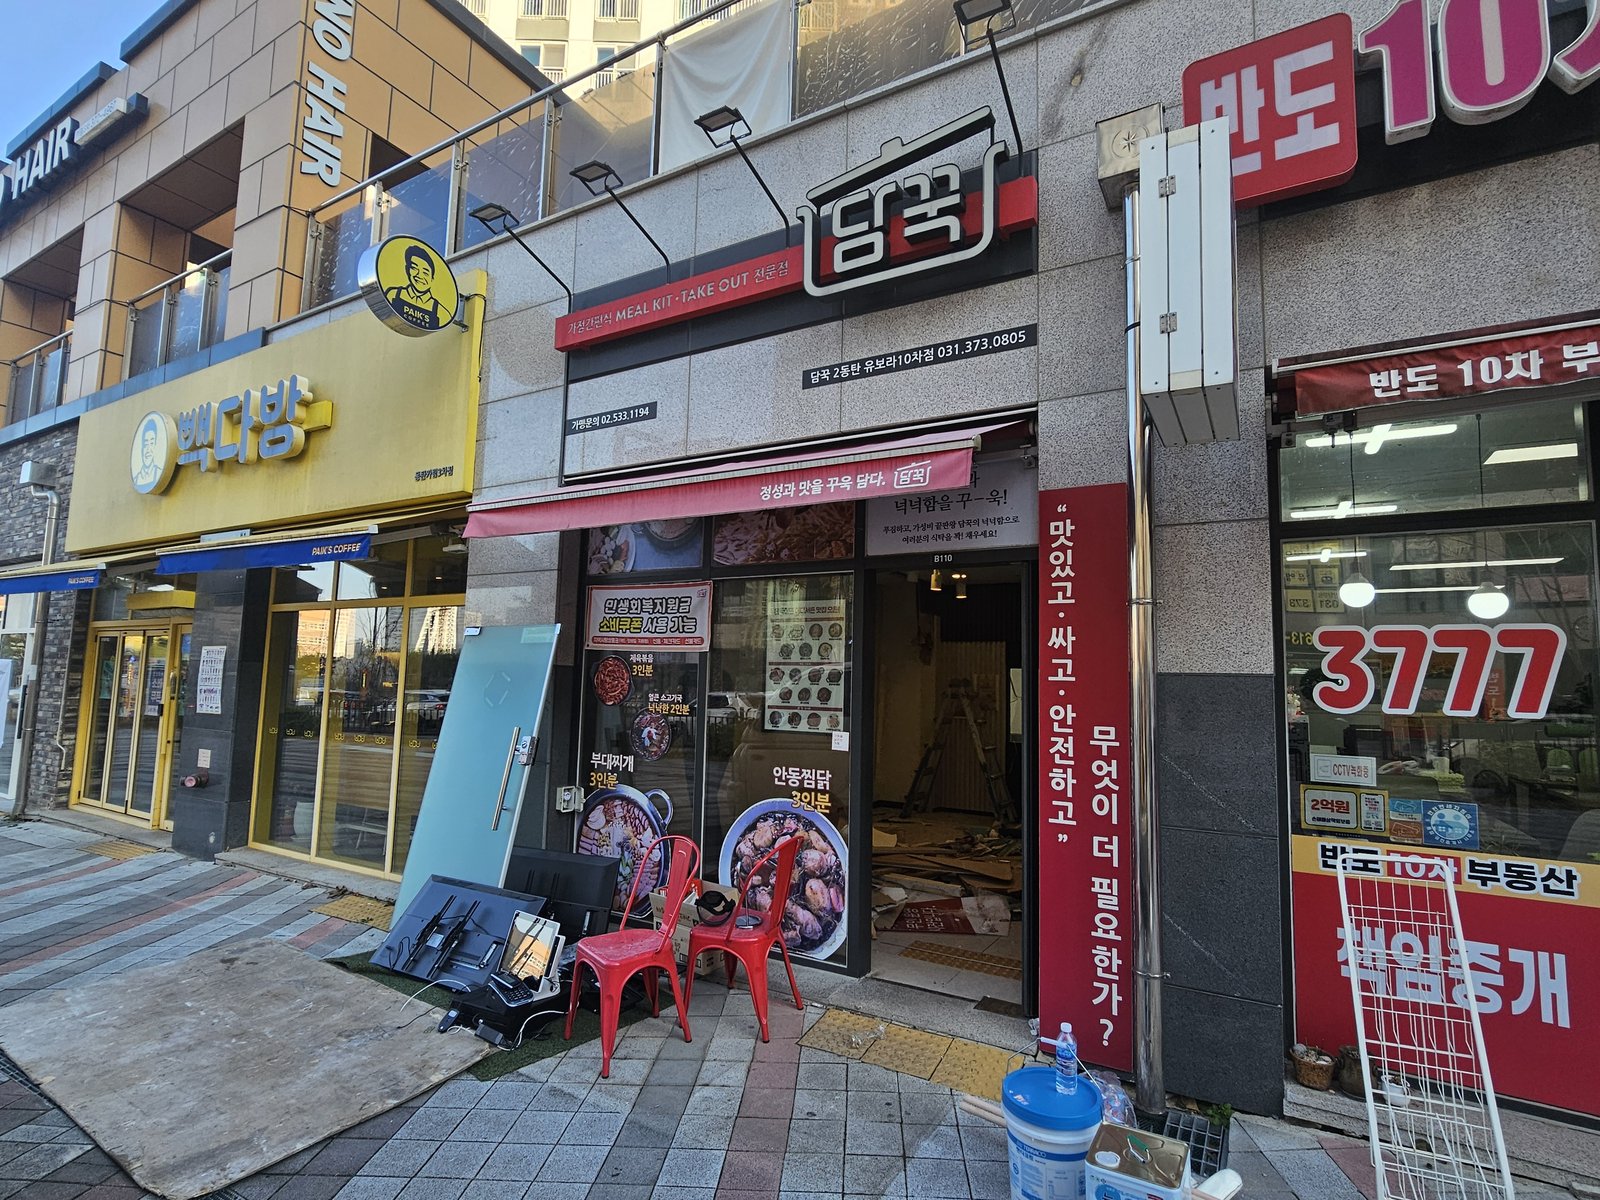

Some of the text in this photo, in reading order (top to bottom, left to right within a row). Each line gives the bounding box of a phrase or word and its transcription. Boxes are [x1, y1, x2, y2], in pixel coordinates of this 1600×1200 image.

[1201, 0, 1600, 177] 반도 10
[300, 61, 347, 187] HAIR
[12, 116, 72, 200] HAIR
[831, 162, 962, 273] 담꾹
[568, 313, 612, 334] 가정간편식
[615, 303, 650, 322] MEAL
[718, 272, 749, 293] OUT
[754, 260, 789, 283] 전문점
[403, 305, 430, 323] PAIK'S
[810, 330, 1027, 385] 담꾹 2동탄 유보라10차점 031.373.0805
[1369, 364, 1439, 398] 반도
[1457, 349, 1544, 387] 10차
[177, 374, 314, 472] 빽다방
[571, 406, 650, 431] 가맹문의 02.533.1194
[759, 482, 796, 501] 정성과
[799, 478, 824, 497] 맛을
[826, 475, 853, 493] 꾸욱
[856, 471, 886, 489] 담다.
[894, 493, 954, 515] 넉넉함을
[912, 521, 934, 532] 가성비
[935, 519, 957, 531] 끝판왕
[958, 517, 980, 529] 담꾹의
[311, 542, 362, 556] PAIK'S COFFEE
[902, 533, 930, 545] 여러분의
[930, 532, 953, 543] 식탁을
[965, 529, 998, 540] 채우세요!
[933, 554, 953, 563] B110
[604, 596, 692, 615] 민생회복지원금
[599, 615, 697, 634] 소비쿠폰 사용 가능
[630, 653, 654, 663] 제육볶음
[632, 664, 654, 677] 3인분
[1312, 623, 1567, 720] 3777
[670, 703, 690, 715] 2인분
[590, 752, 634, 773] 부대찌개
[589, 771, 619, 790] 3인분
[773, 766, 832, 790] 안동찜닭
[791, 790, 832, 814] 3인분
[1310, 798, 1350, 815] 2억원
[1319, 843, 1383, 875] 반도
[1466, 857, 1580, 898] 부동산
[1089, 725, 1123, 1047] 무엇이 더 필요한가?
[1336, 923, 1571, 1030] 책임중개
